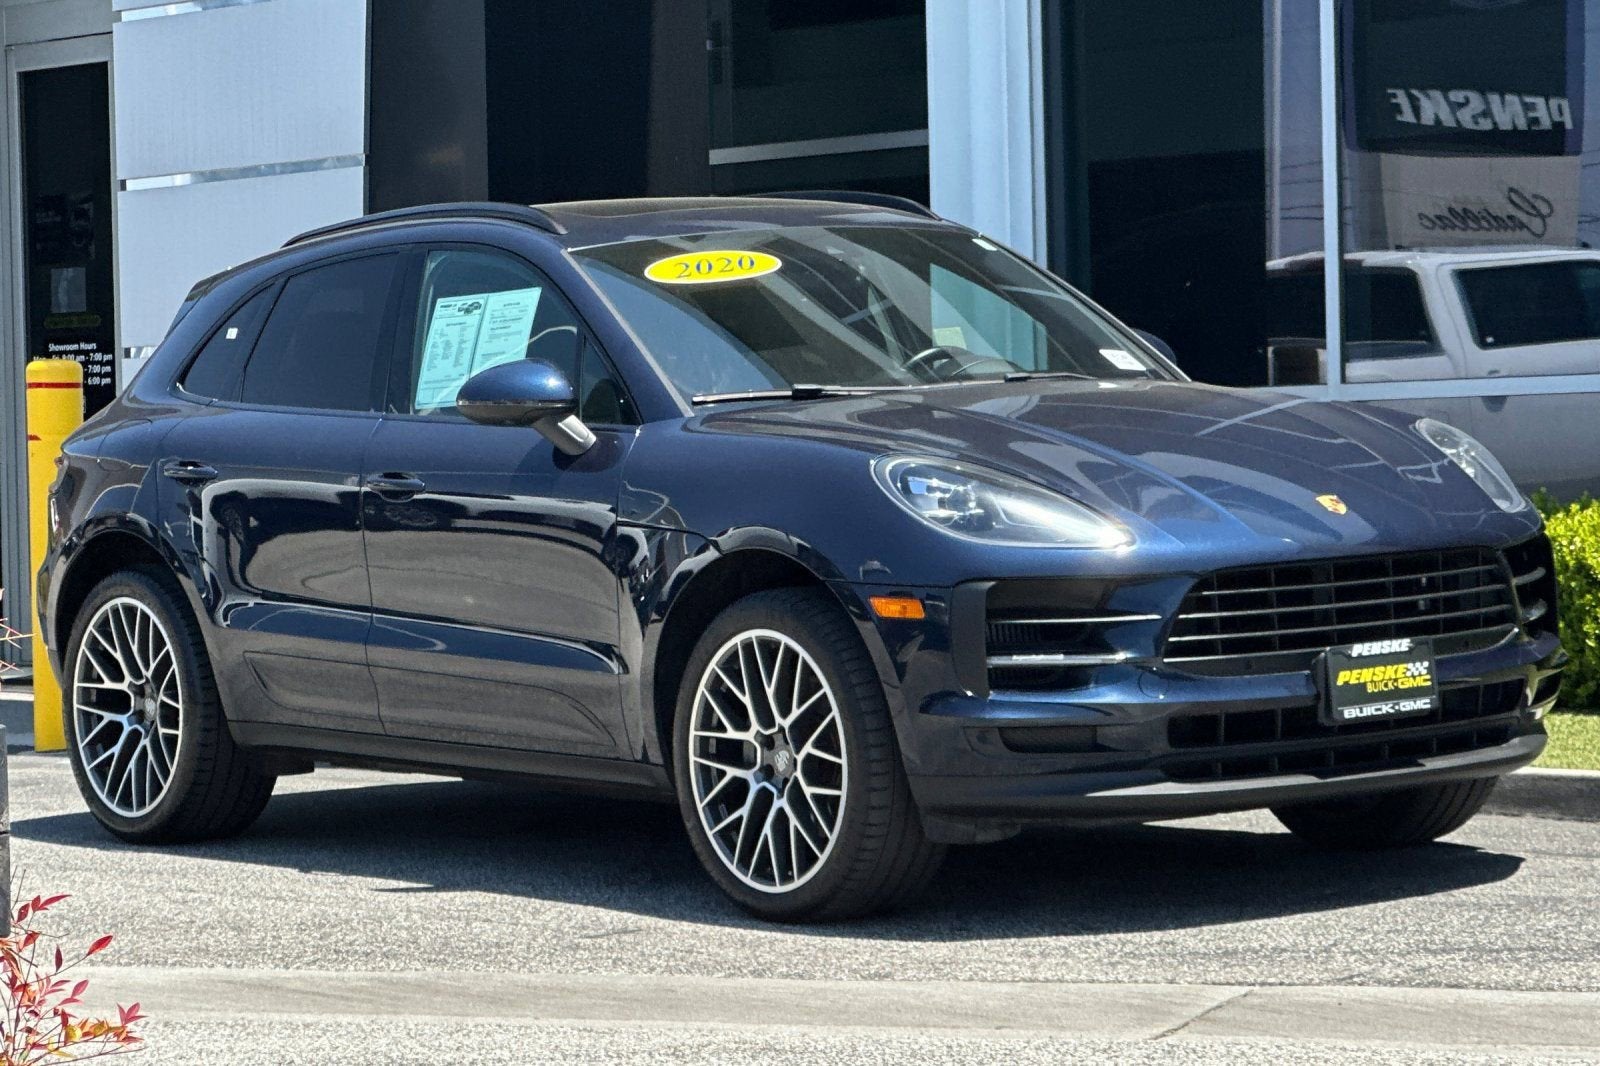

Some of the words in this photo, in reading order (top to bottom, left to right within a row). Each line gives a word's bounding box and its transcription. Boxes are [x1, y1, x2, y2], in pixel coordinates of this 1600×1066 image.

[674, 255, 755, 279] 2020
[48, 343, 79, 352] Showroom
[80, 341, 97, 350] Hours
[89, 352, 102, 361] 7:00
[103, 353, 113, 362] pm
[88, 365, 101, 373] 7:00
[101, 365, 111, 374] pm
[88, 376, 101, 385] 6:00
[101, 377, 111, 386] pm
[1351, 639, 1411, 657] PENSKE
[1336, 663, 1408, 686] PENSKE
